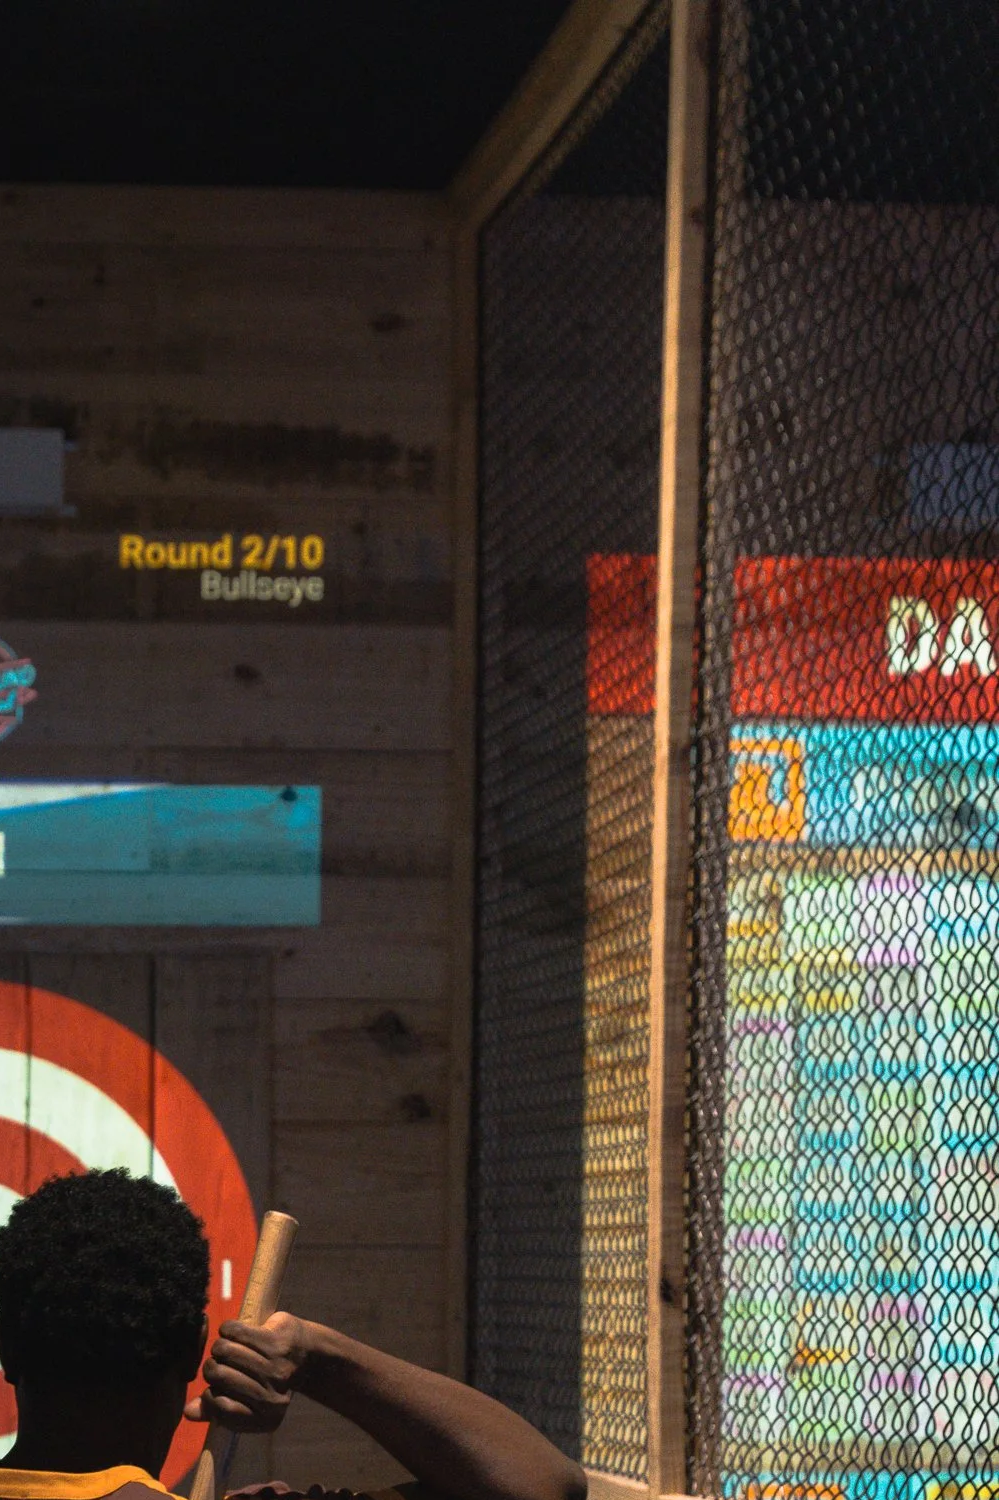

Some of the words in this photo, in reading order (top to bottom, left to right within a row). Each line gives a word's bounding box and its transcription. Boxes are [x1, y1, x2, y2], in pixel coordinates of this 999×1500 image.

[119, 533, 233, 570] Round
[240, 533, 325, 571] 2/10
[200, 569, 325, 608] Bullseye
